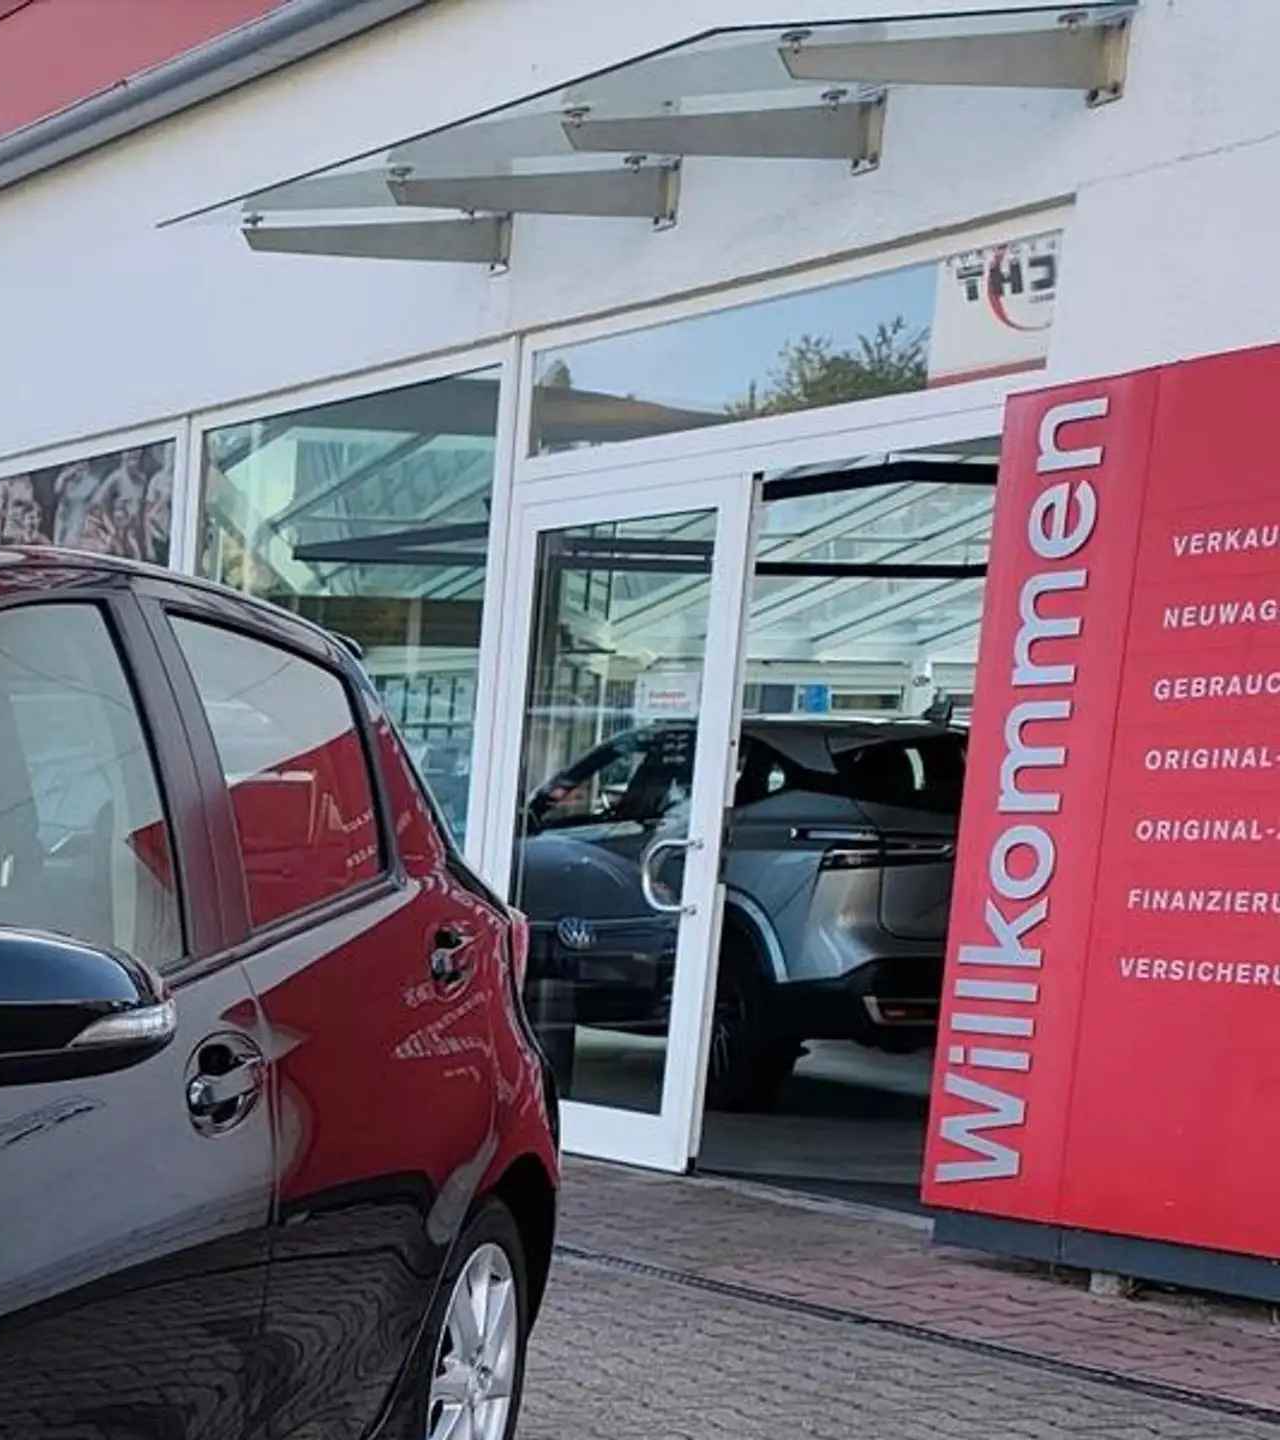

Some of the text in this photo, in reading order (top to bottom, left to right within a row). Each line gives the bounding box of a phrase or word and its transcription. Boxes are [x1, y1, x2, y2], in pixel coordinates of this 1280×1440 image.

[1174, 526, 1278, 556] VERKAU
[1164, 599, 1277, 628] NEUWAG
[1154, 672, 1280, 701] GEBRAUC
[934, 396, 1109, 1182] Willkommen
[1136, 820, 1280, 842] ORIGINAL-
